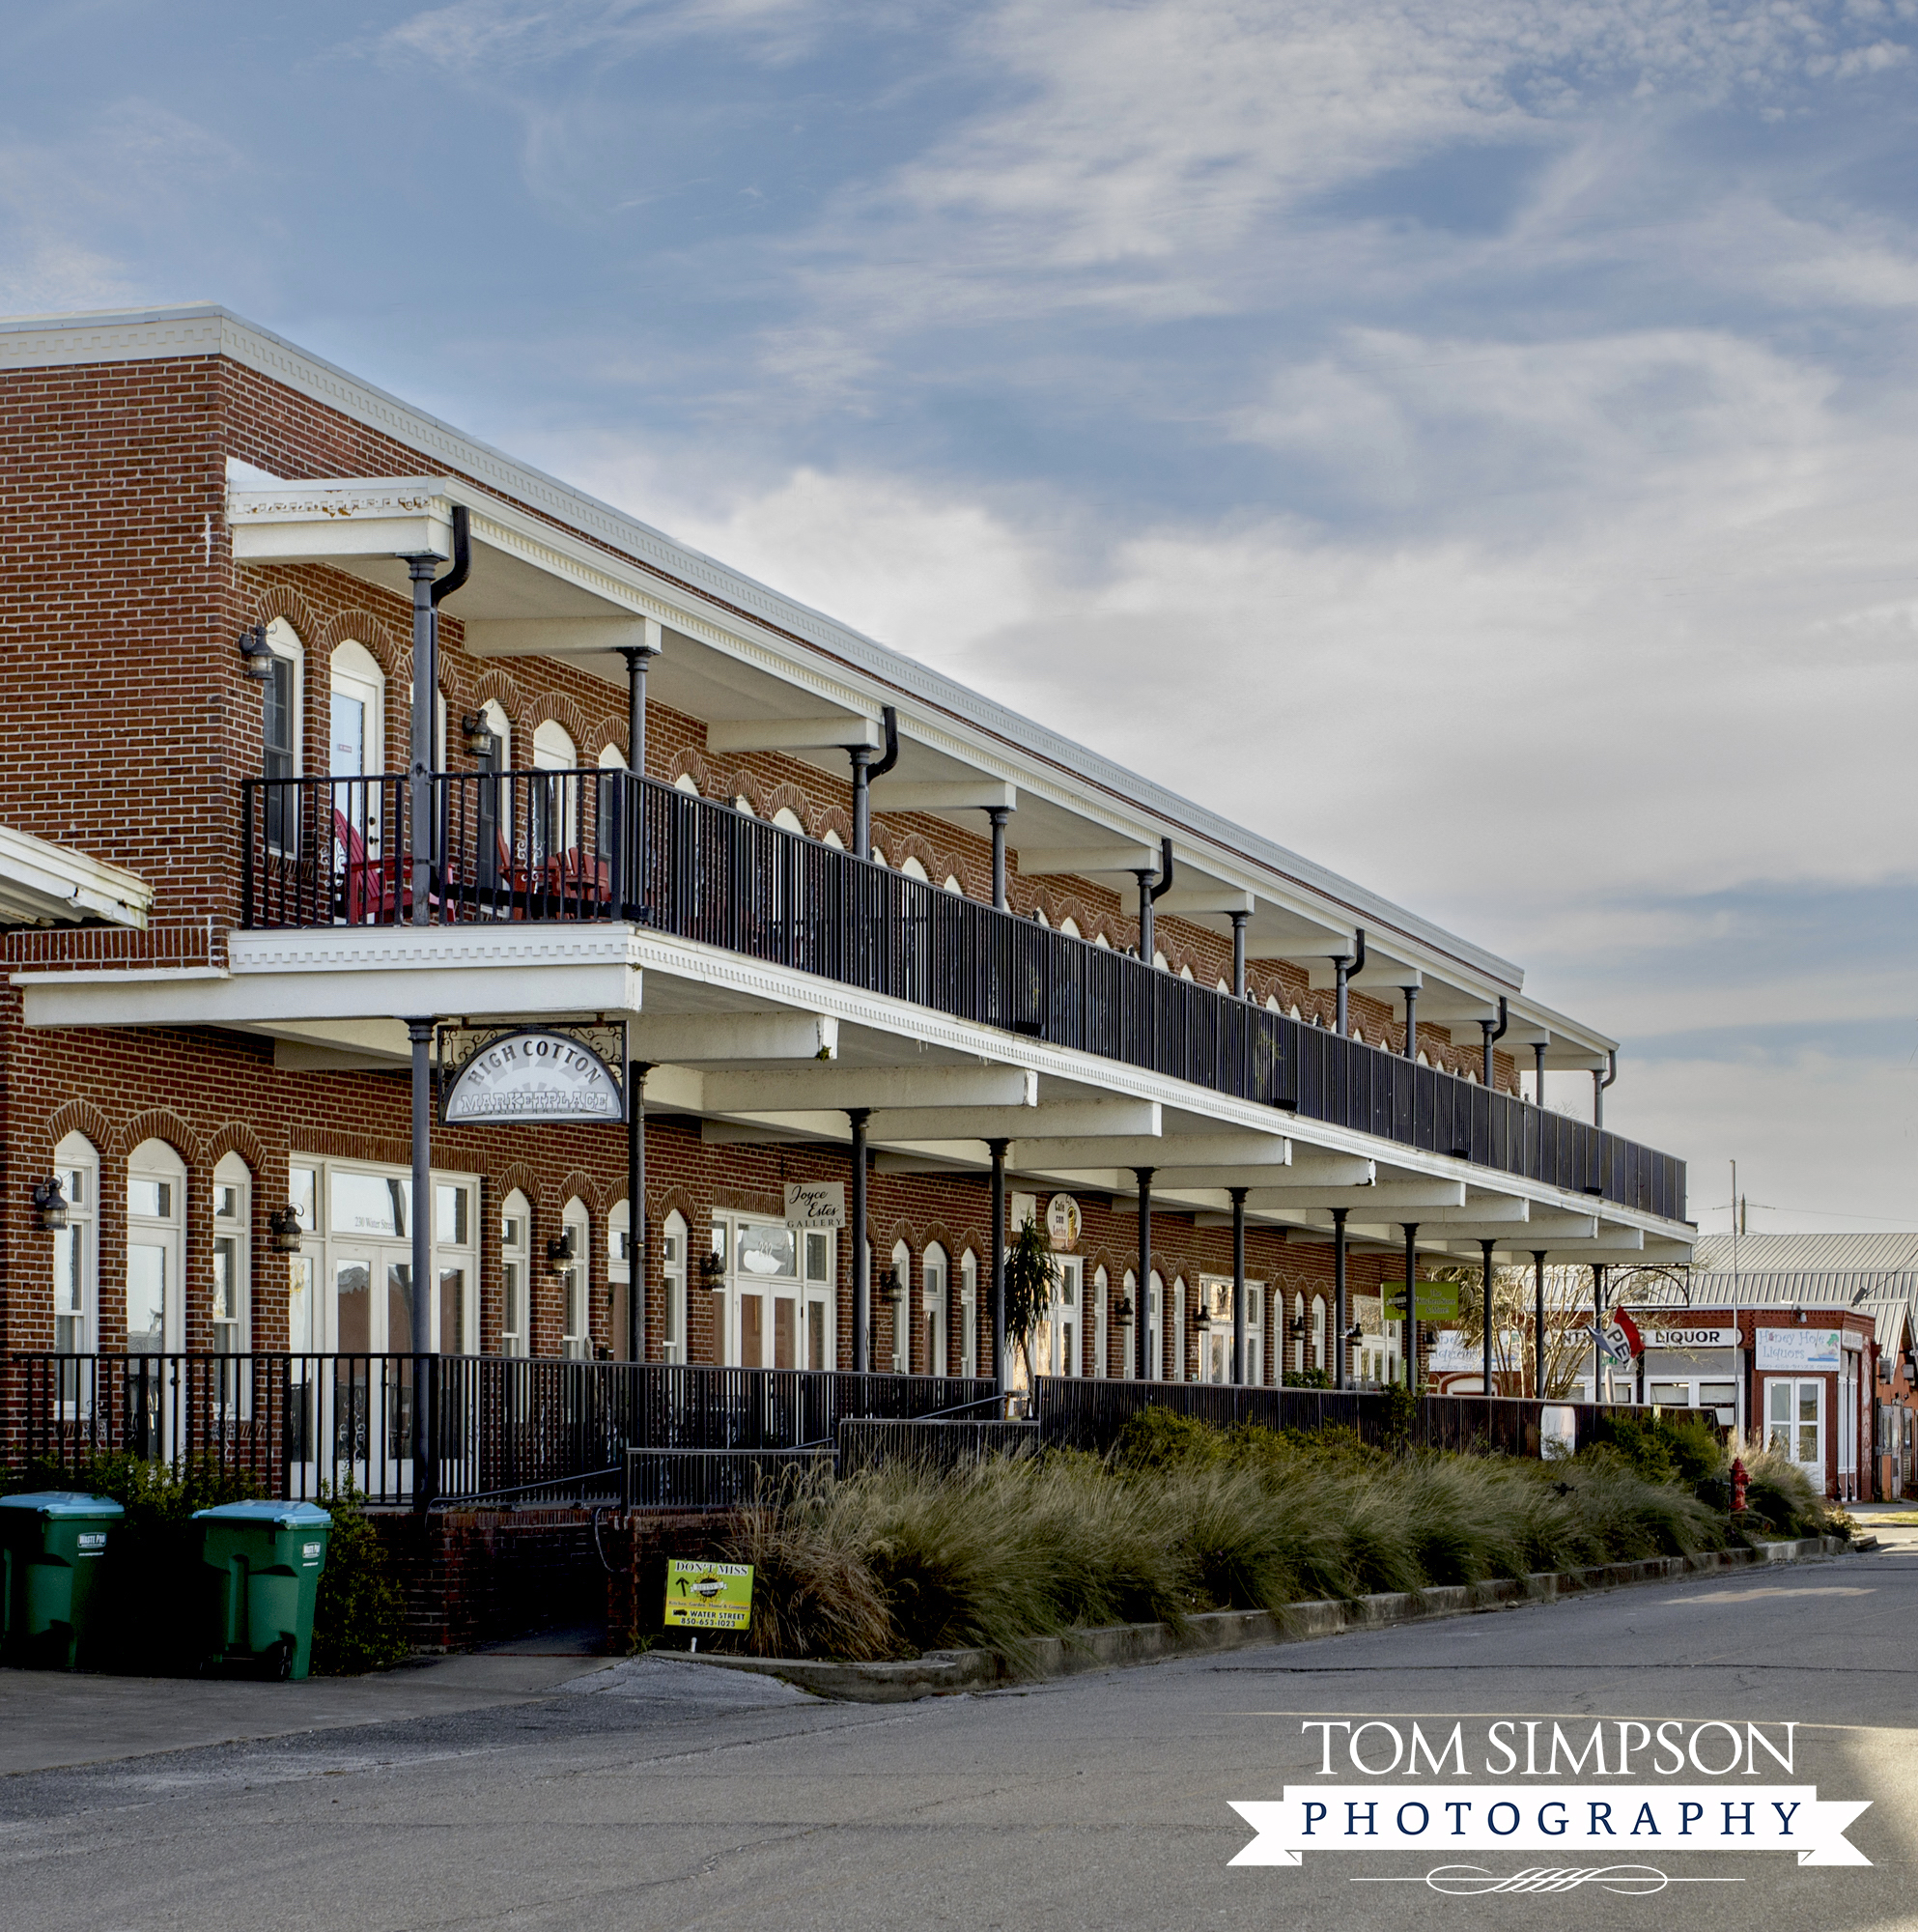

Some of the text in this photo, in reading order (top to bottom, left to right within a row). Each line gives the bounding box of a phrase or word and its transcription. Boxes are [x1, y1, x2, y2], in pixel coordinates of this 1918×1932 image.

[467, 1040, 601, 1086] HIGH COTTON
[461, 1091, 608, 1113] MARKETPLACE
[789, 1185, 829, 1206] Joyce
[807, 1202, 840, 1217] Estes
[366, 1217, 381, 1229] Water
[787, 1219, 842, 1228] GALLERY
[1056, 1215, 1064, 1224] con
[1655, 1331, 1720, 1345] LIQUOR
[1798, 1330, 1825, 1346] Hole
[1763, 1346, 1805, 1361] Liquors
[675, 1561, 748, 1576] DON'T MISS
[681, 1618, 736, 1627] 850-653-1023
